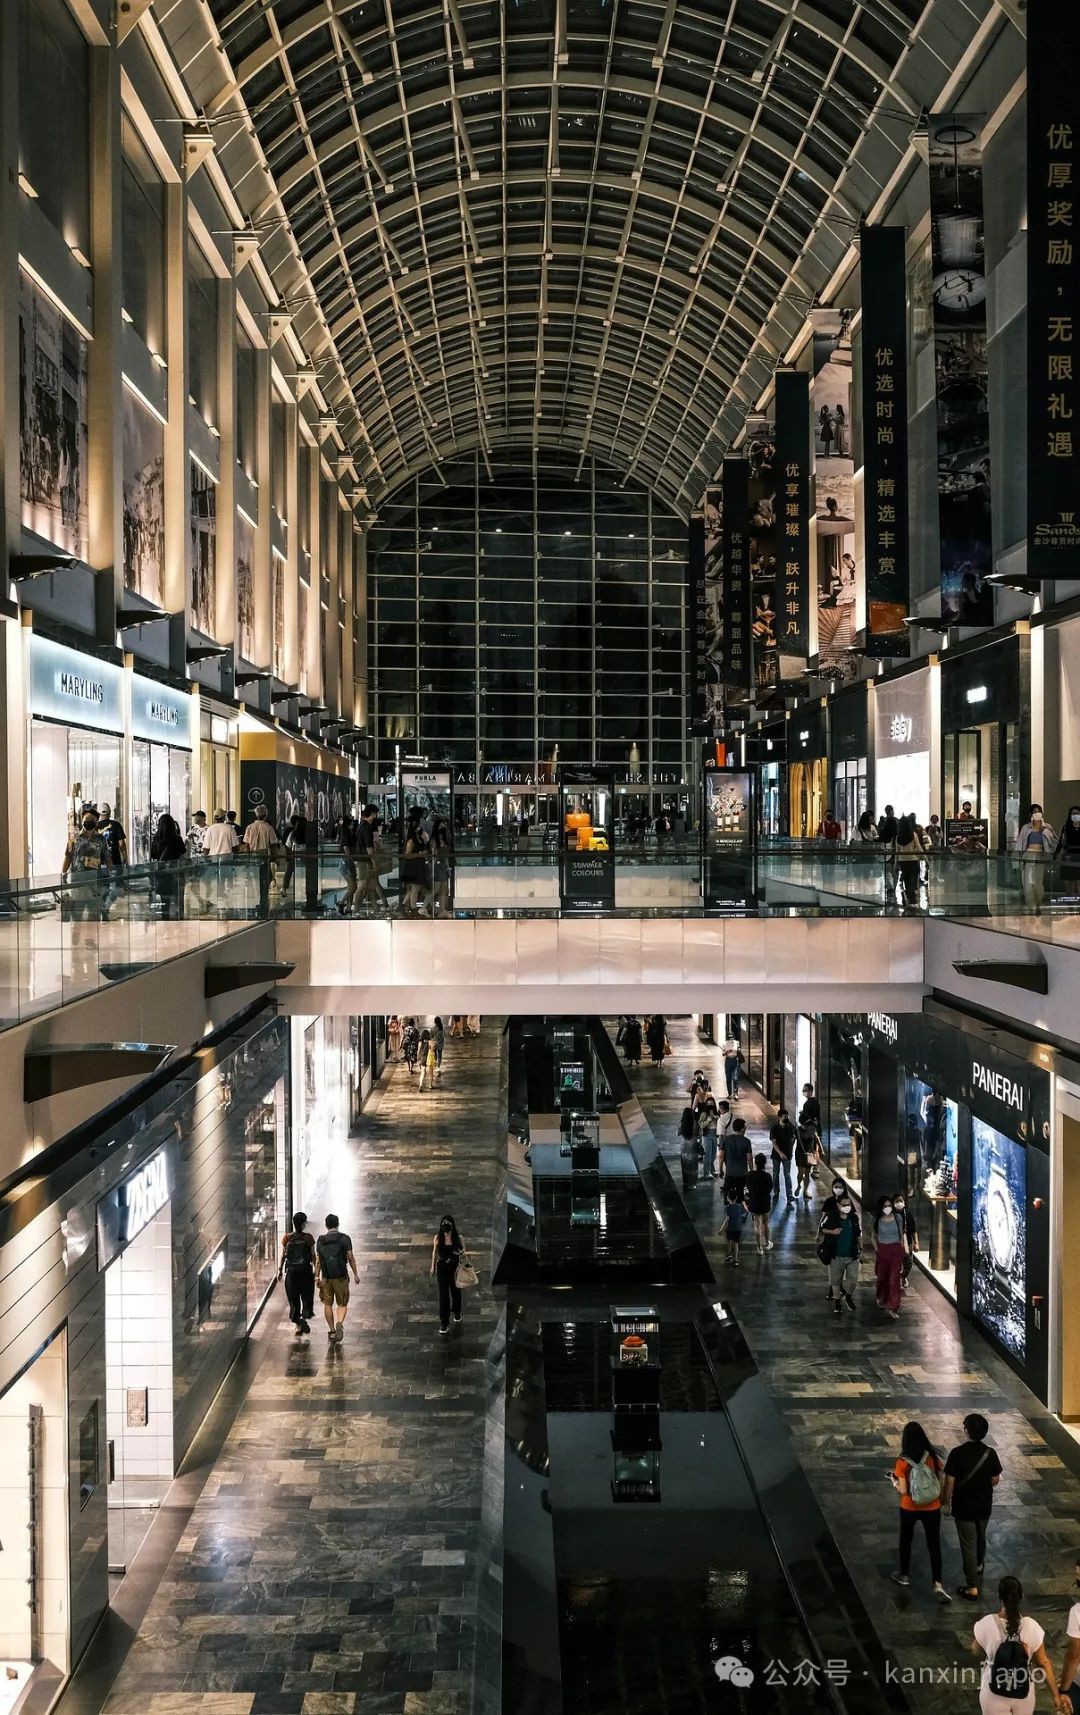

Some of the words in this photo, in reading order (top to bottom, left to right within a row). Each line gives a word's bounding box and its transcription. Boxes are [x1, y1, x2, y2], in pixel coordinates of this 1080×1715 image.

[1046, 122, 1073, 458] 优厚奖励，无限礼遇
[874, 347, 896, 577] 优选时尚，精选丰赏
[785, 463, 800, 635] 优享璀璨，跃升非凡
[60, 672, 103, 702] MARYLING
[151, 702, 178, 725] MARYLING
[572, 869, 604, 877] COLOURS
[867, 1012, 898, 1041] PANERAI
[973, 1061, 1024, 1112] PANERAI
